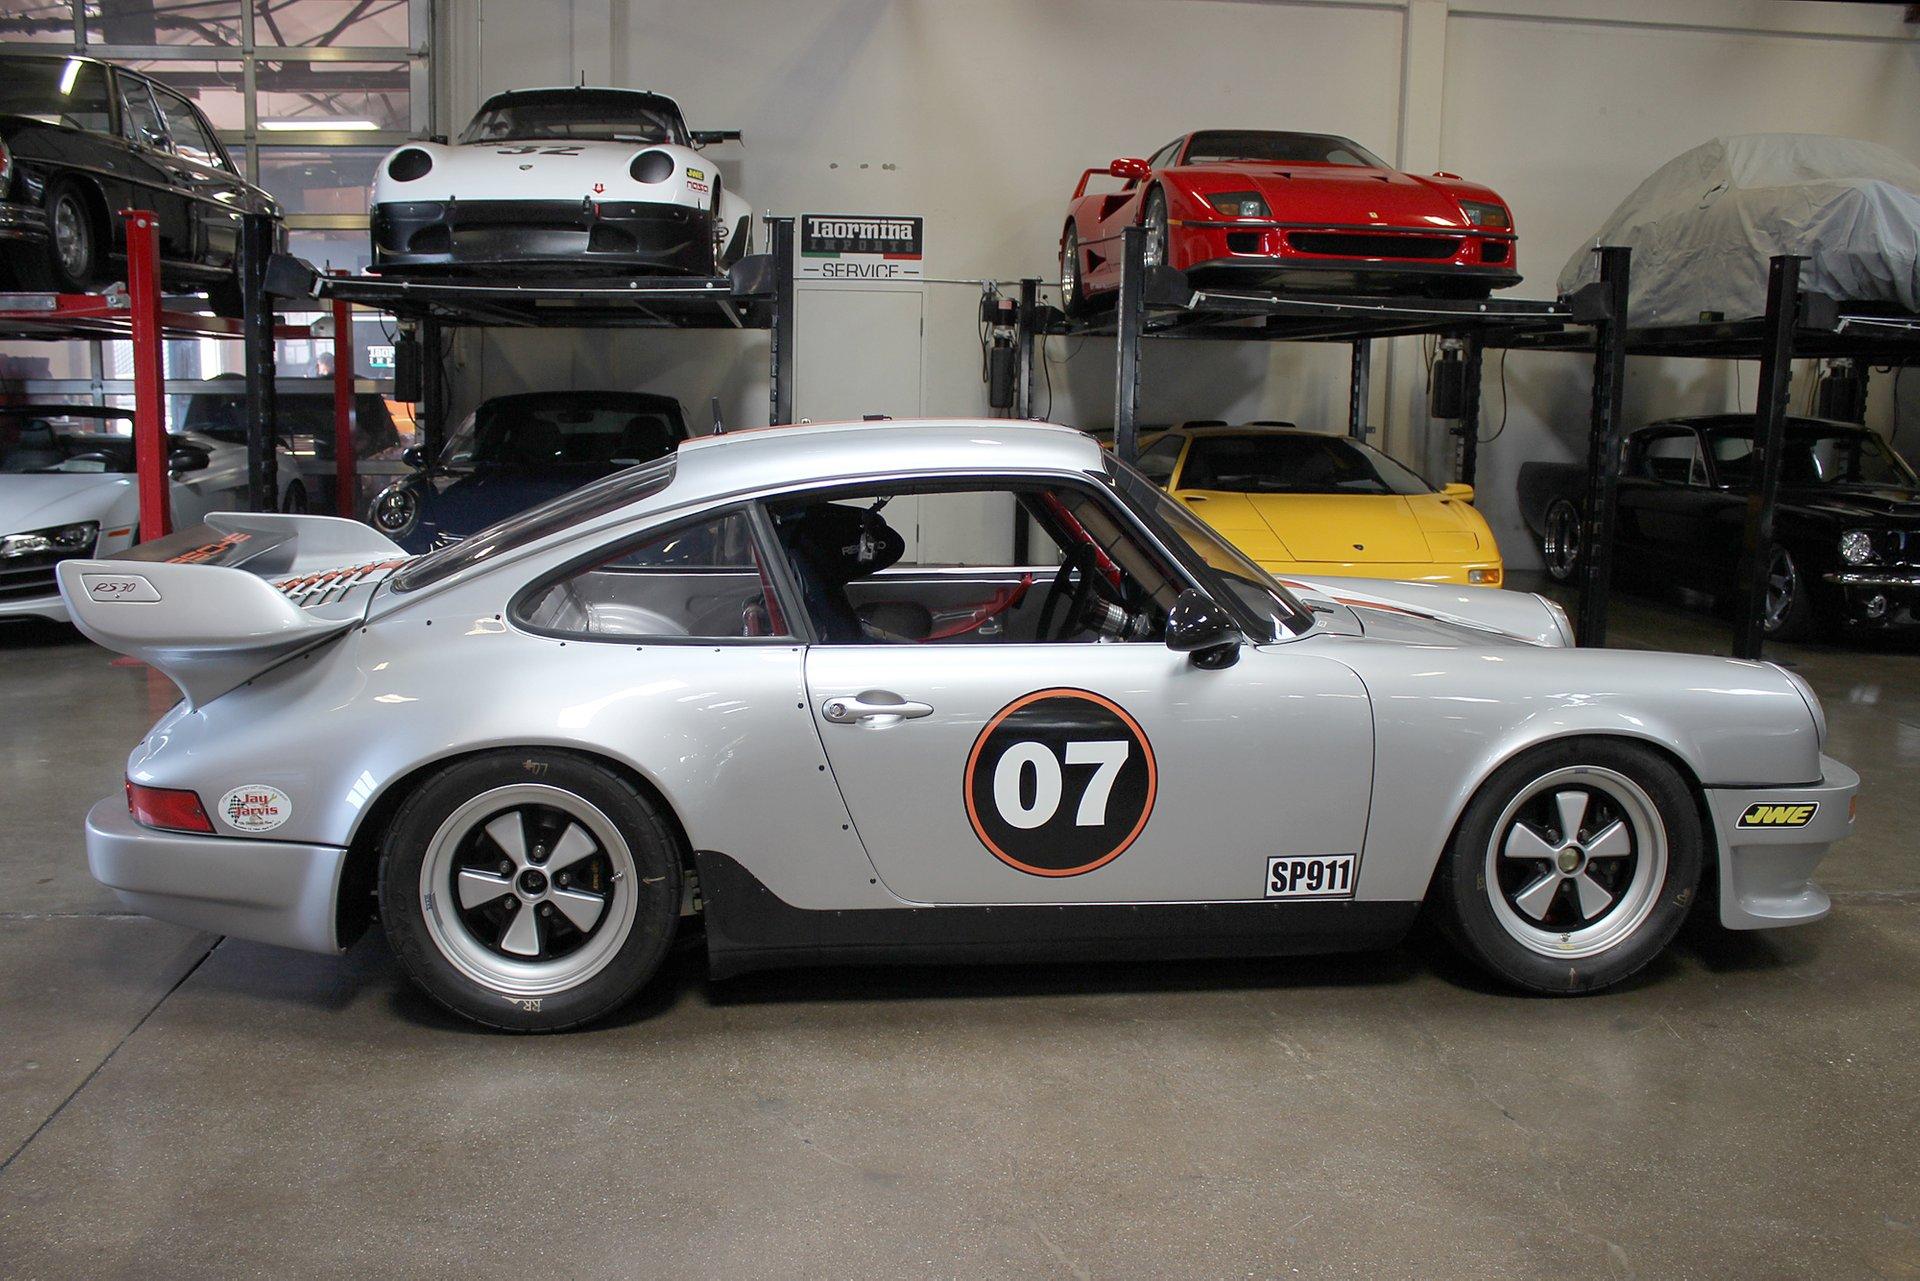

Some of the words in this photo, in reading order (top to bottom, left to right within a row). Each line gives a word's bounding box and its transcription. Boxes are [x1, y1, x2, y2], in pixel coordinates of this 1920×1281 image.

[808, 217, 915, 240] Taormina
[810, 240, 914, 252] IMPORTS
[822, 262, 900, 278] SERVICE
[993, 740, 1129, 829] 07
[244, 794, 269, 805] Jay
[235, 806, 279, 818] Jarvis
[1745, 806, 1814, 824] JWE
[1271, 859, 1350, 892] SP911
